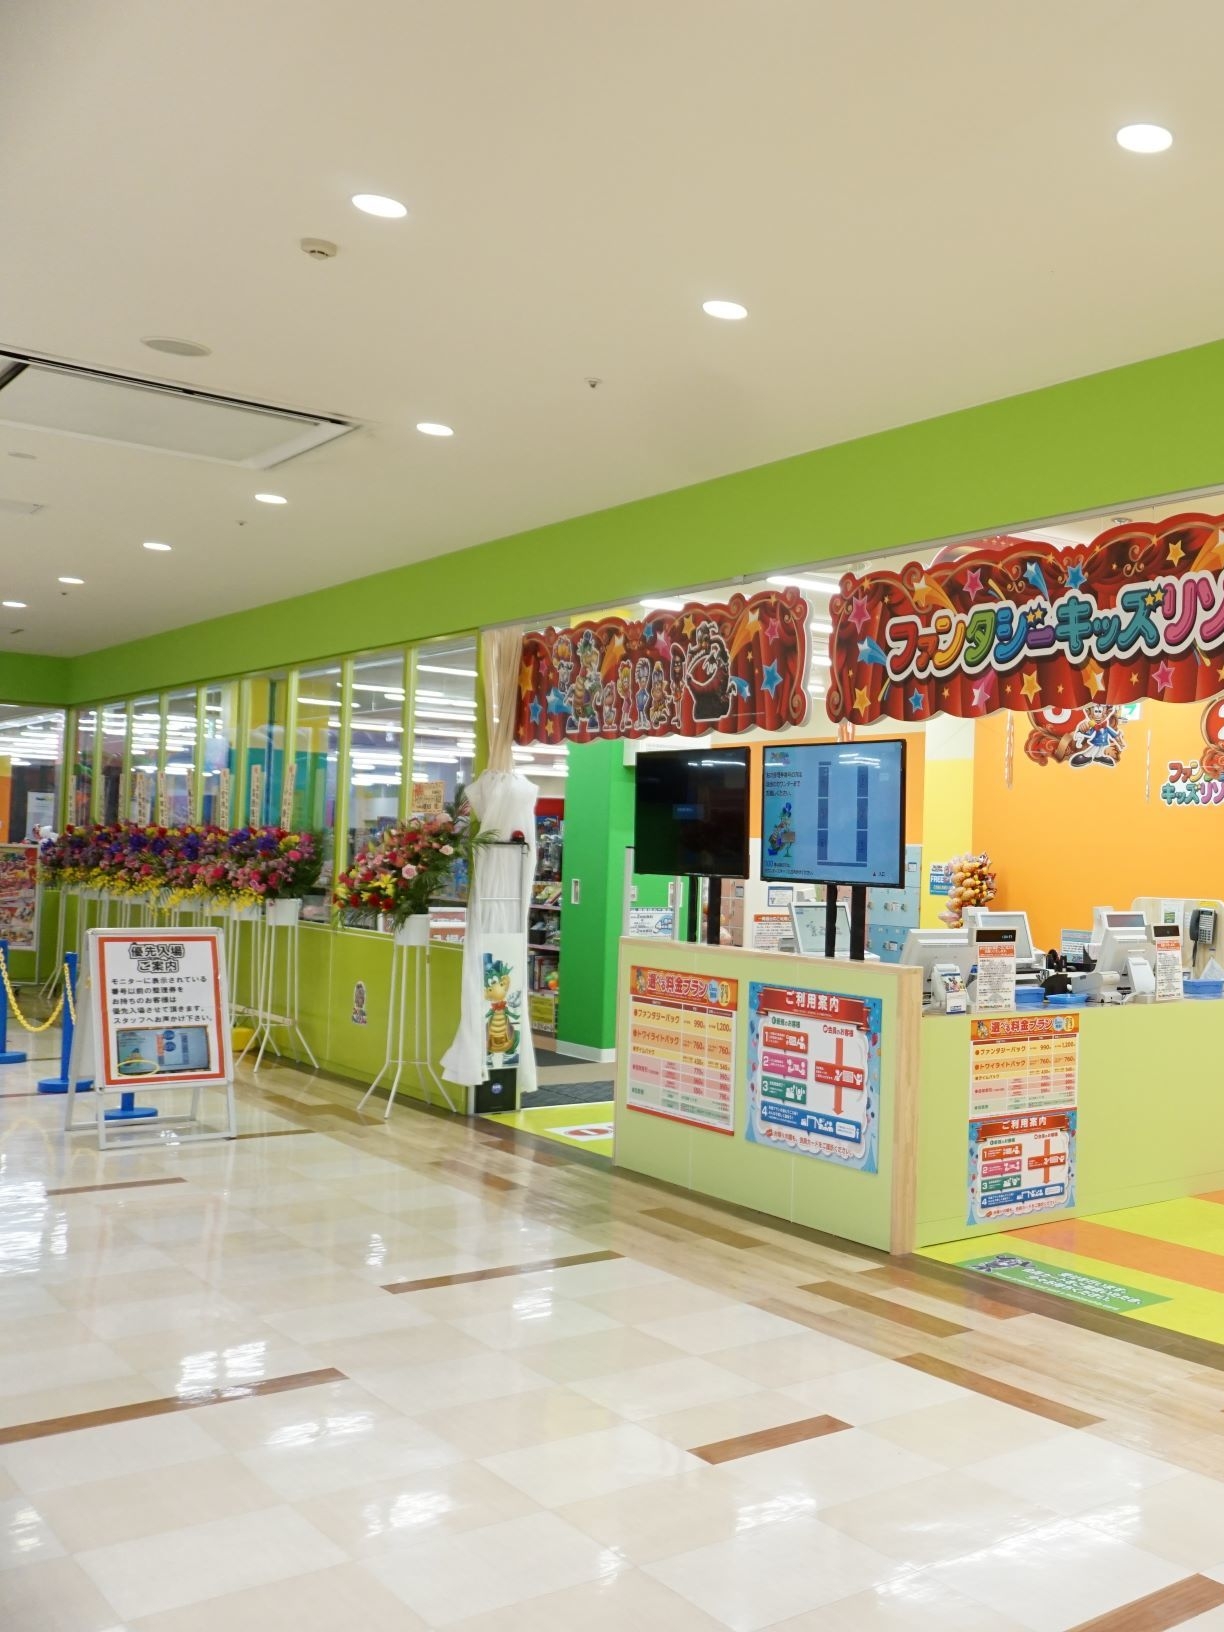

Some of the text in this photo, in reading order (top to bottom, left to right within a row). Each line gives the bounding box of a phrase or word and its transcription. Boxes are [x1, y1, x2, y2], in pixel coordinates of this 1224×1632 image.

[130, 944, 184, 958] 優先入場
[138, 960, 179, 972] ご案内
[111, 975, 208, 985] モニターに表示されている
[647, 973, 709, 999] 選べる料金プラン
[112, 996, 177, 1005] お持ちのお客様は
[785, 989, 840, 1013] ご利用案内
[112, 1005, 205, 1015] 優先入場させて頂きます。
[113, 1015, 213, 1024] スタッフへお声かけ下さい。
[637, 1008, 681, 1025] ファンタジーパック
[991, 1018, 1053, 1033] 選べる料金プラン
[637, 1029, 680, 1046] トワイライトパック
[980, 1045, 1026, 1055] ファンタジーパック
[763, 1056, 769, 1067] 2
[980, 1060, 1026, 1069] トワイライトパック
[762, 1080, 769, 1091] 3
[761, 1105, 768, 1117] 4
[1002, 1116, 1047, 1130] ご利用案内
[982, 1166, 988, 1174] 2
[982, 1182, 988, 1190] 3
[981, 1198, 988, 1206] 4
